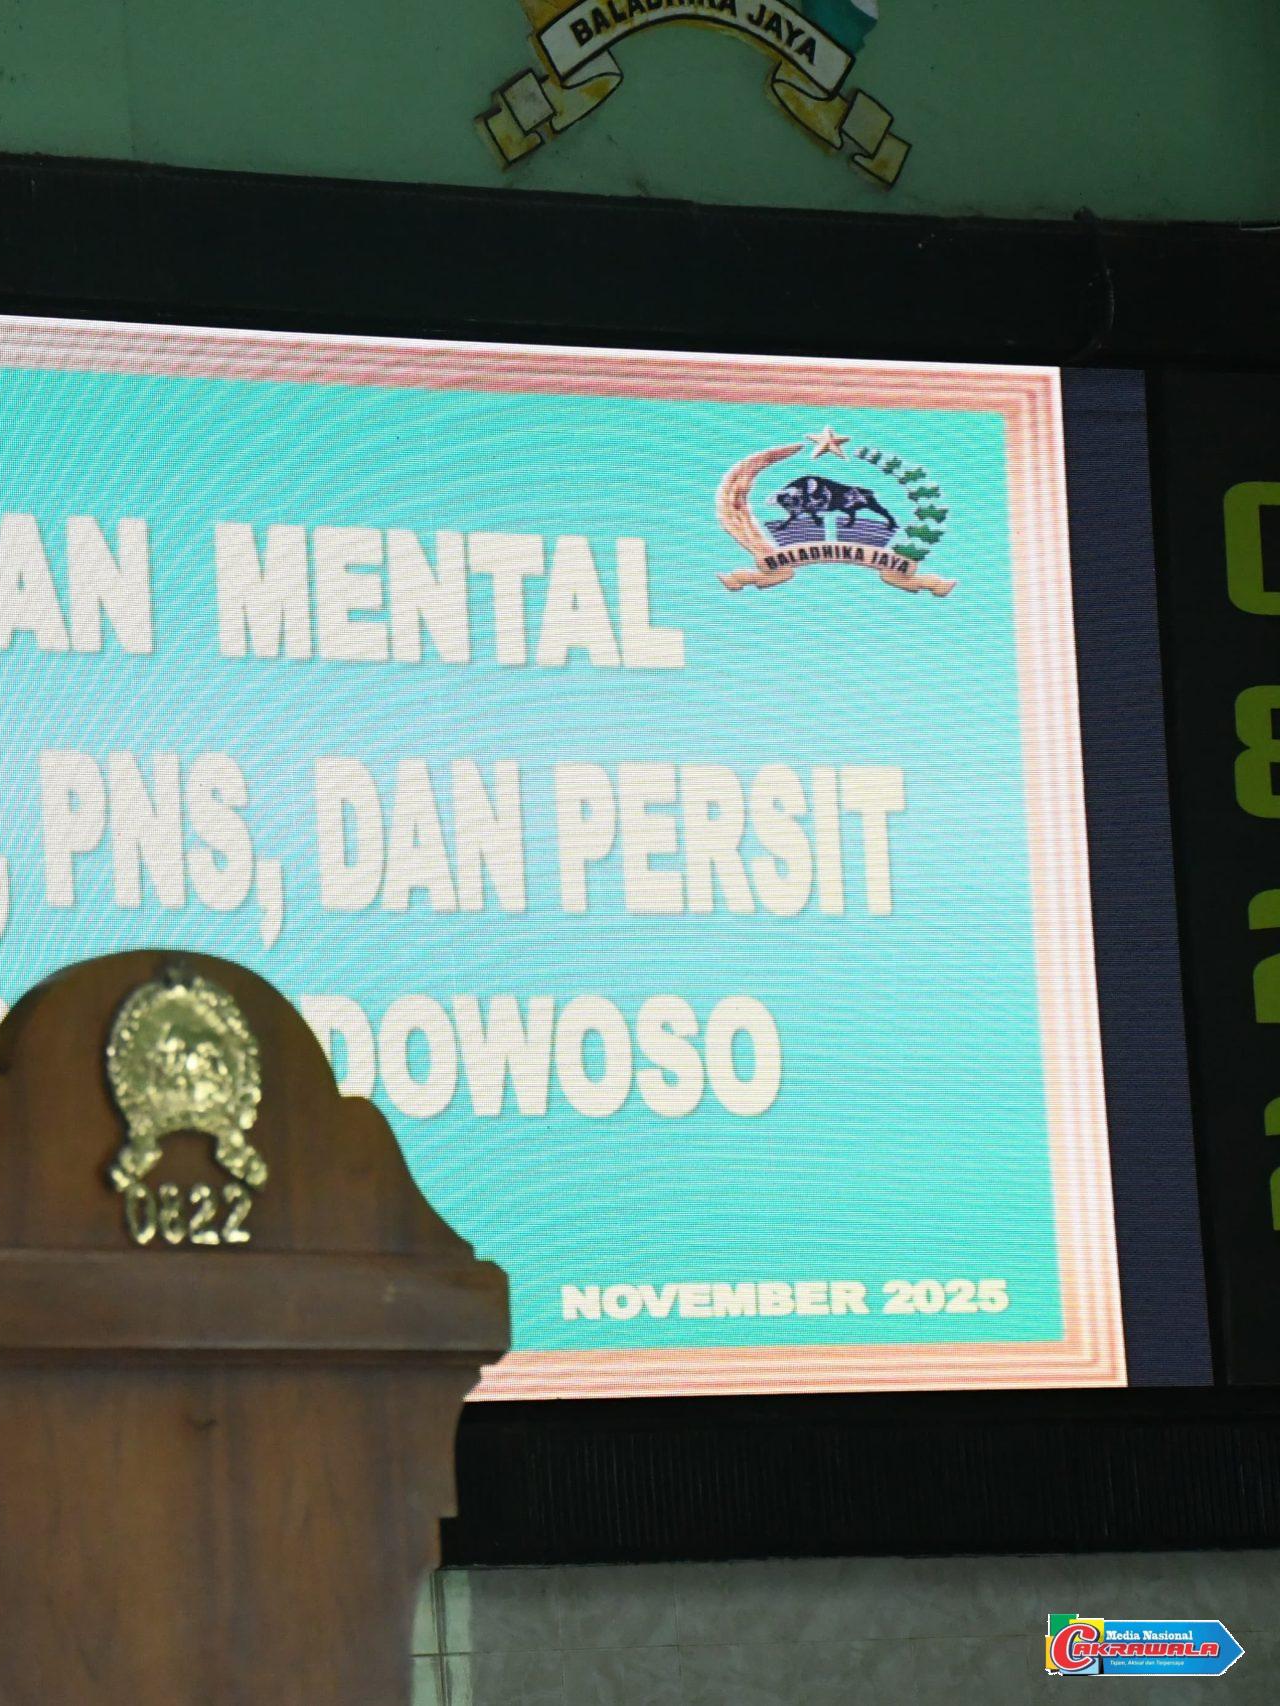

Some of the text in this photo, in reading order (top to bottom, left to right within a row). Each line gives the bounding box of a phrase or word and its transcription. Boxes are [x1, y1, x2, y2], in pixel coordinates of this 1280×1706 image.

[748, 4, 816, 65] JAYA
[764, 545, 911, 574] BALADHIKA JAYA
[216, 521, 686, 669] MENTAL
[39, 748, 285, 949] PNS,
[315, 756, 527, 913] DAN
[553, 759, 907, 916] PERSIT
[126, 1183, 253, 1245] 0822
[560, 1278, 1010, 1320] NOVEMBER 2025
